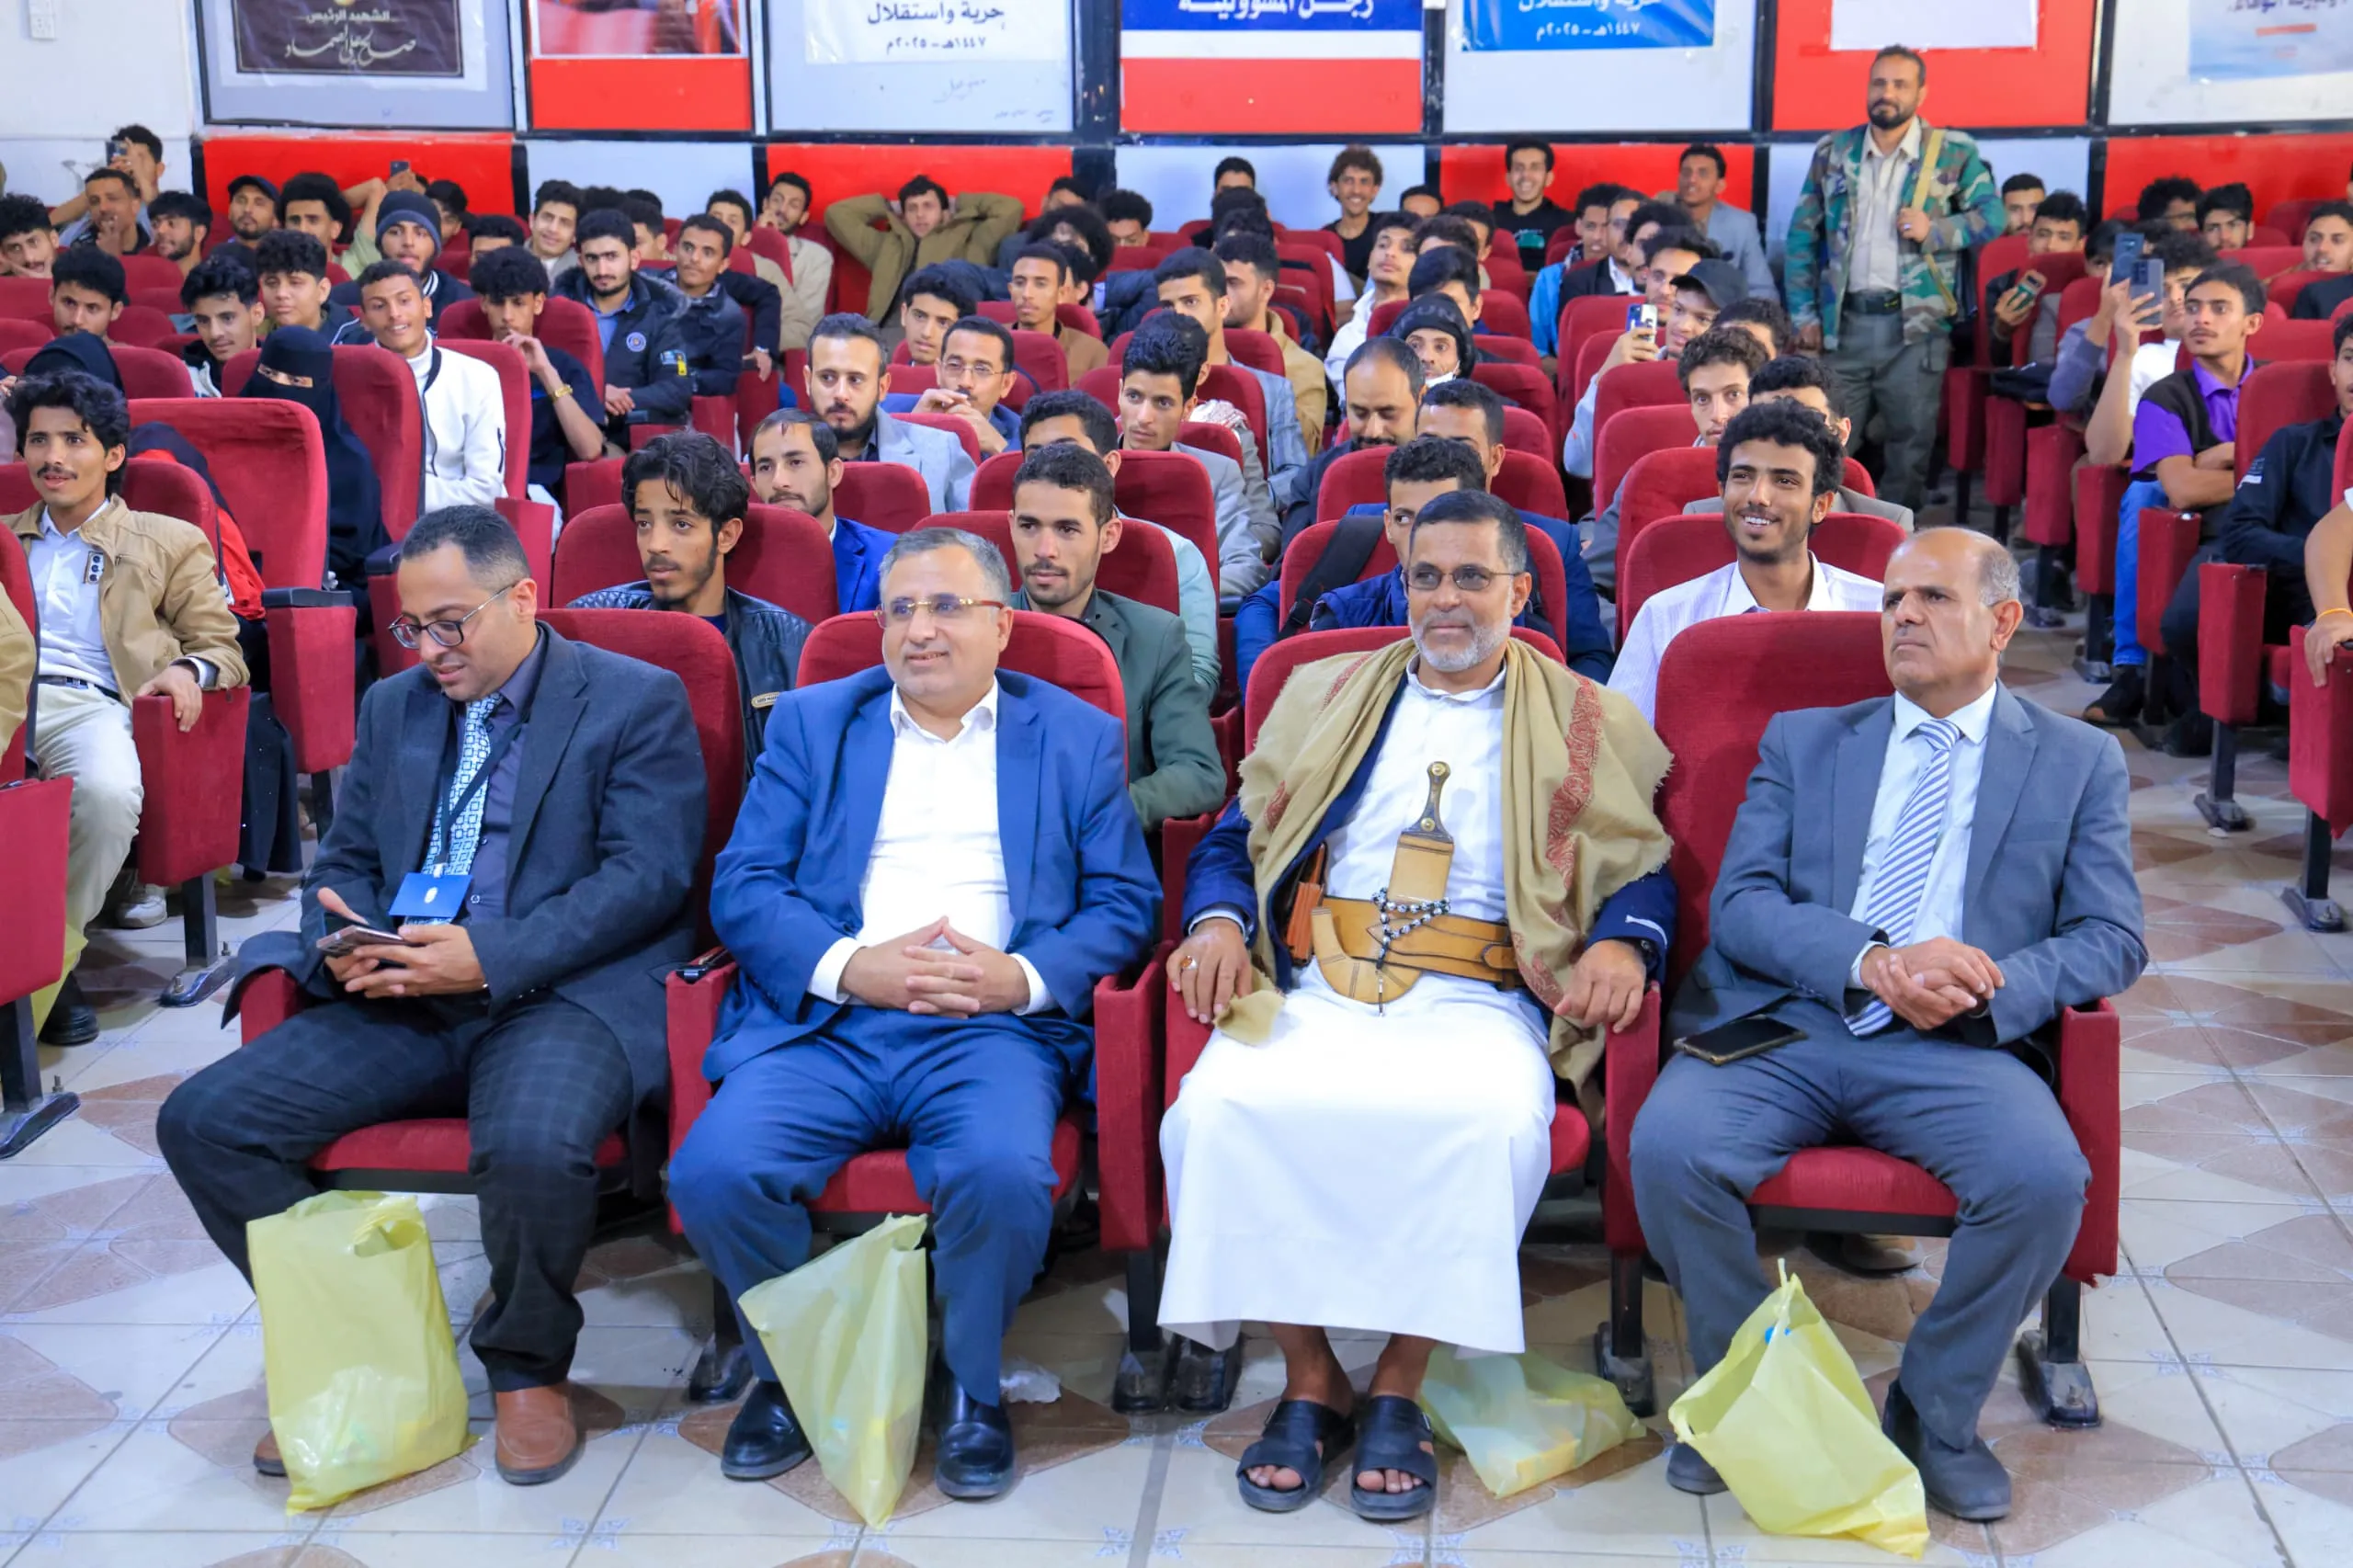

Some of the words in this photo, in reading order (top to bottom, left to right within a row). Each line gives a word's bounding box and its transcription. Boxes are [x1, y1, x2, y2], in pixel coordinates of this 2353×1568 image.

[306, 7, 347, 24] الرئيس
[348, 7, 391, 23] الشهيد
[867, 2, 955, 24] واستقلال
[961, 1, 1005, 24] حرية
